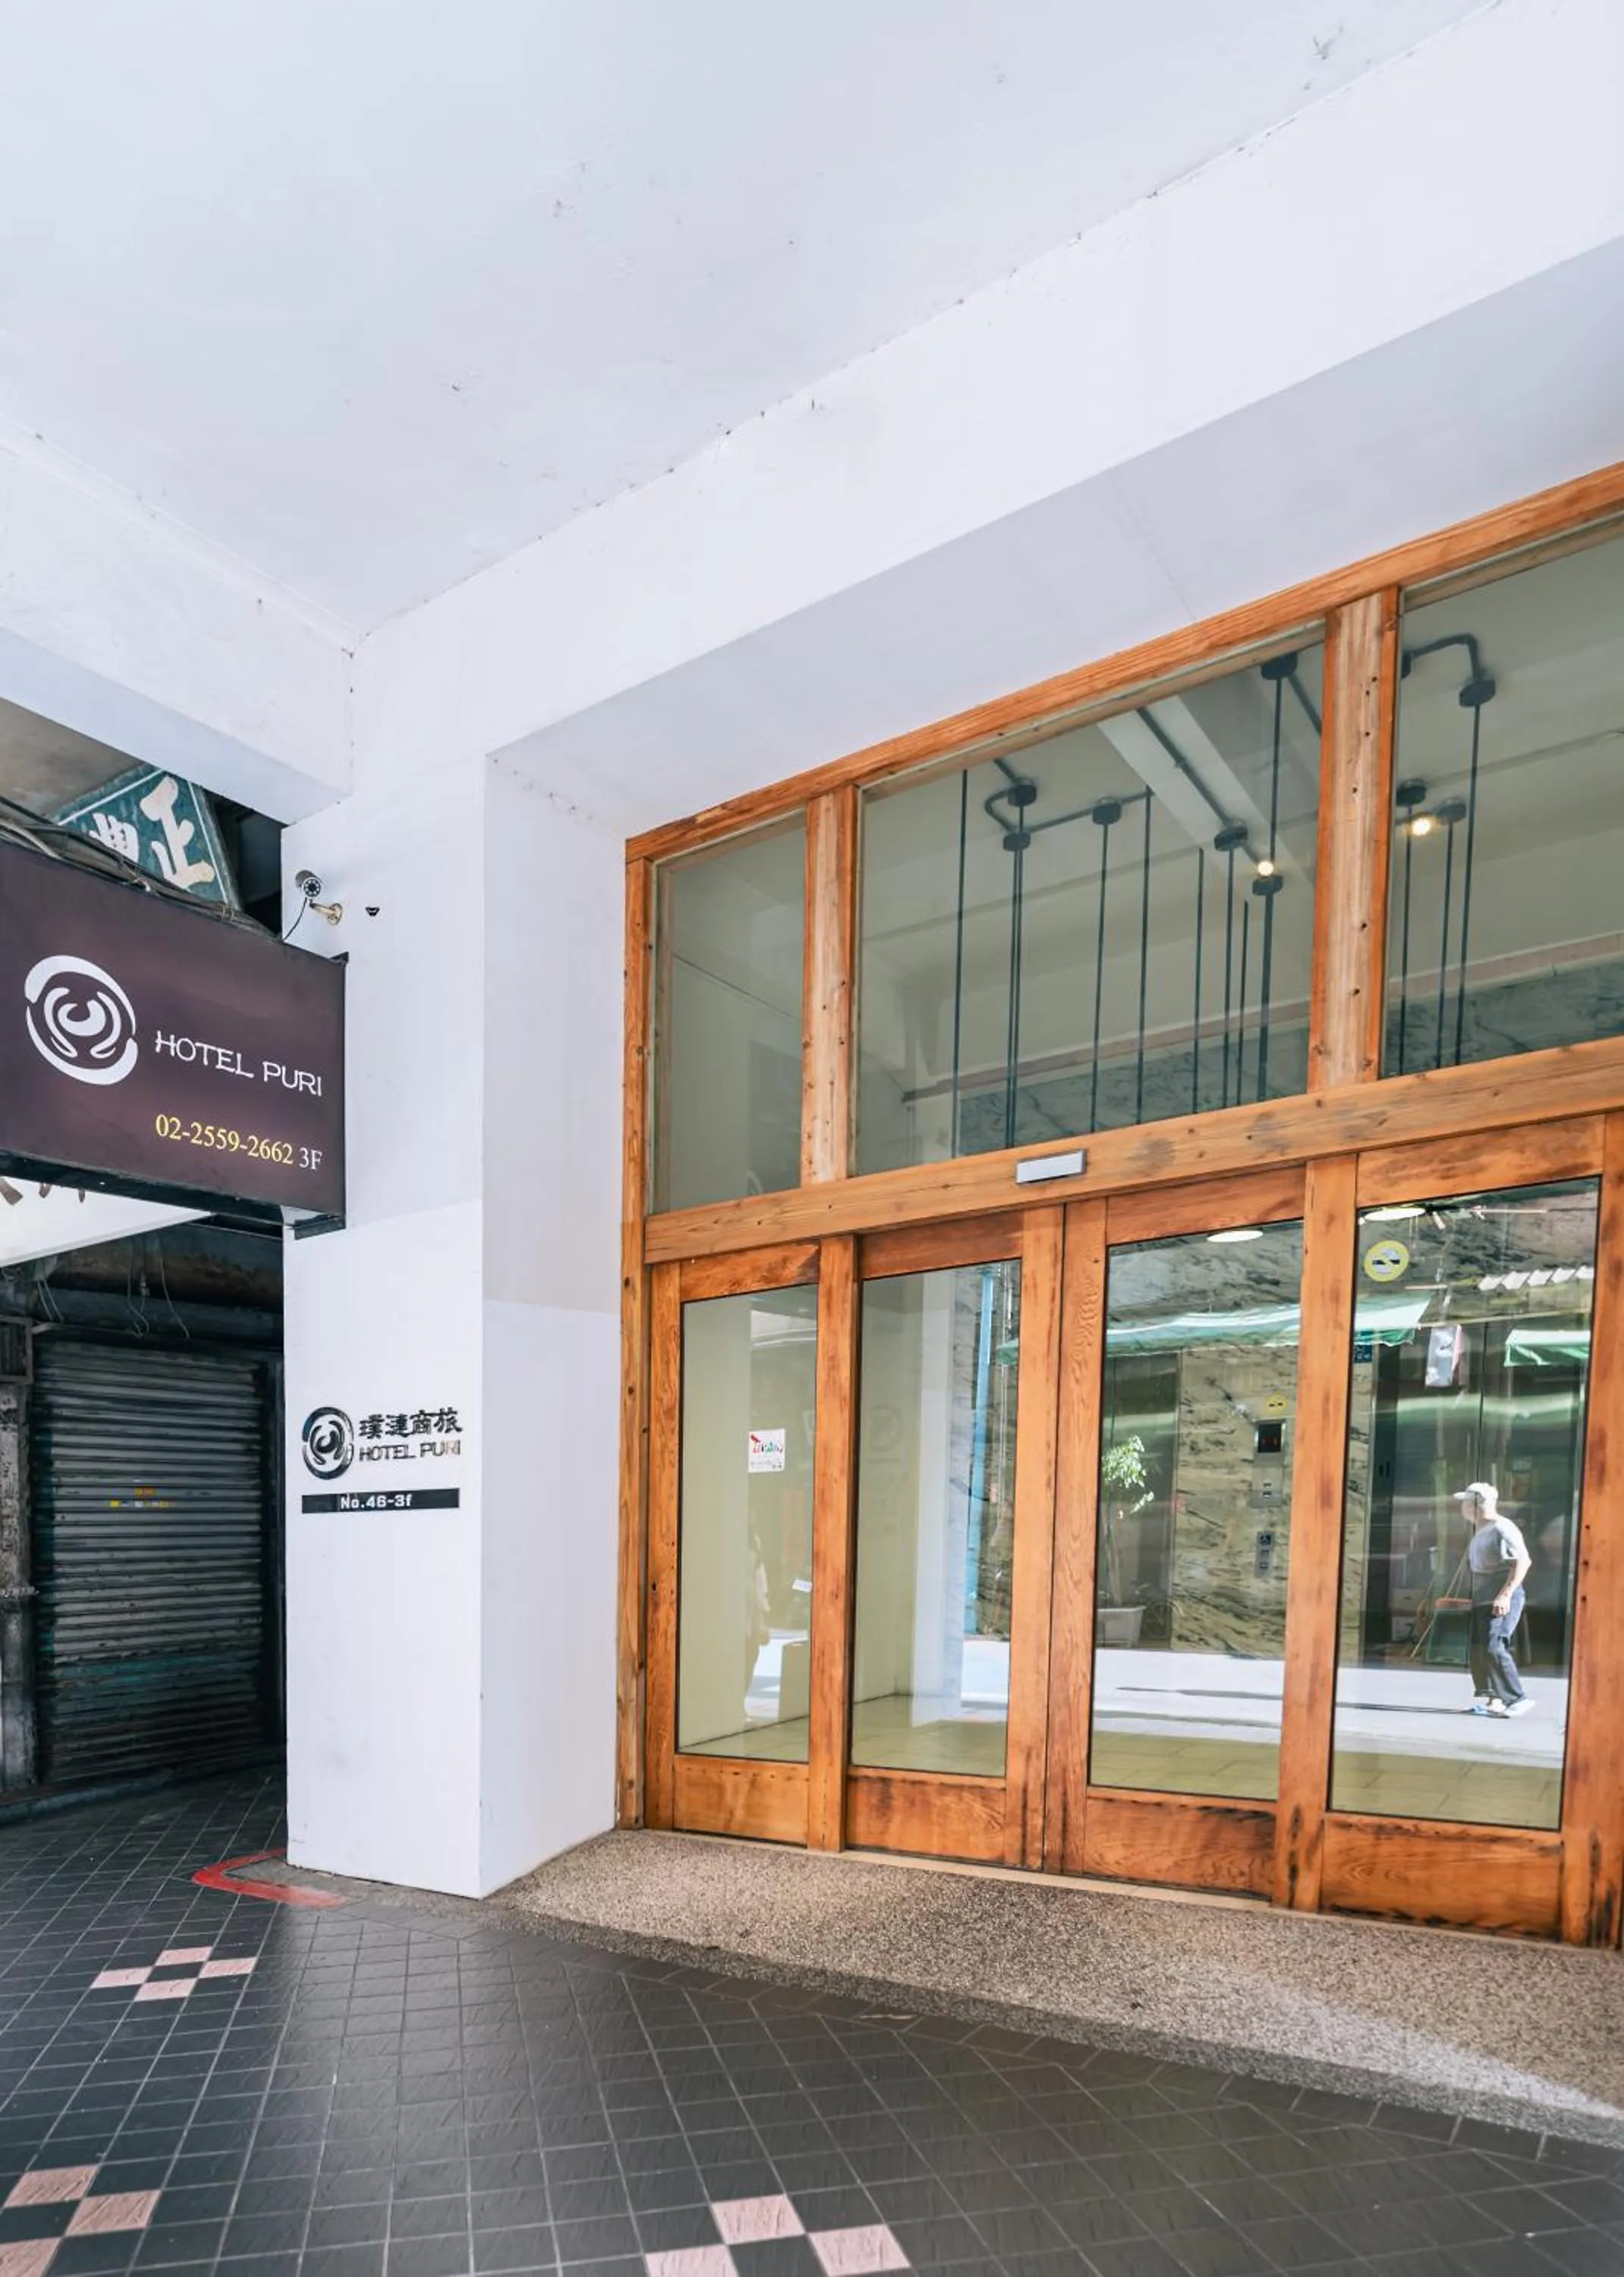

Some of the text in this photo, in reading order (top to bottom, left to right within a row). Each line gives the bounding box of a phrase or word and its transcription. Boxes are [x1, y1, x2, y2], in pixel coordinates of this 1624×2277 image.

[155, 1030, 323, 1096] HOTEL PURI
[156, 1113, 323, 1170] 02-2559-2662 3F
[359, 1440, 461, 1461] HOTEL PURI
